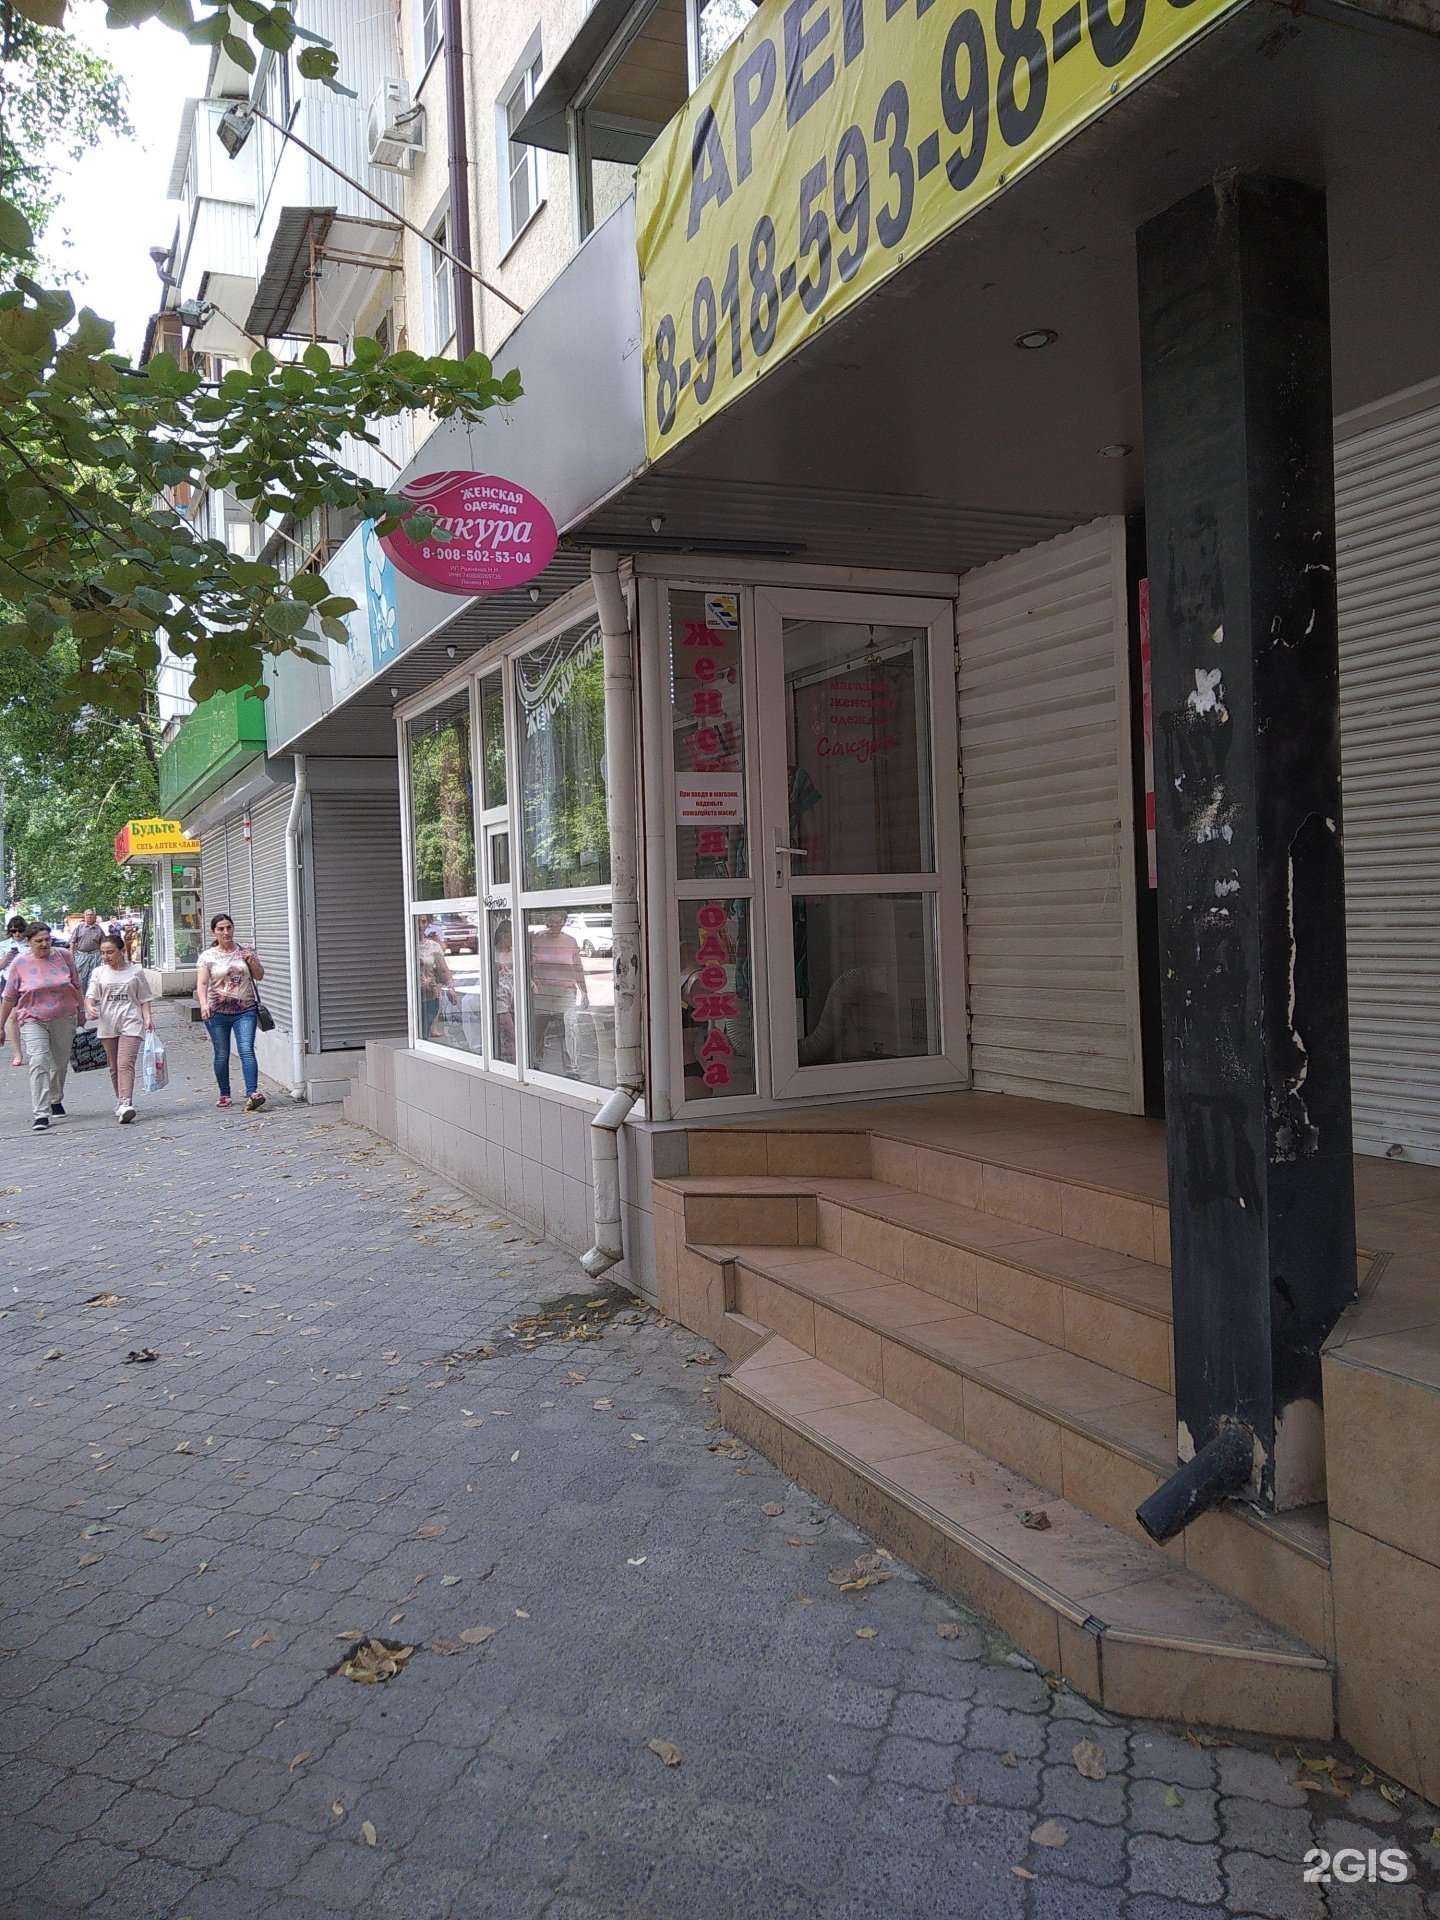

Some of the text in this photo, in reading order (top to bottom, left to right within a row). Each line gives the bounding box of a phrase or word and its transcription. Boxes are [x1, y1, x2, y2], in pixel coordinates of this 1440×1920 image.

[687, 0, 936, 241] АРЕ
[655, 0, 1196, 436] 8-918-593-98-
[461, 487, 524, 503] ЖЕНСКАЯ
[464, 500, 518, 515] одежда
[131, 822, 176, 837] Будьте
